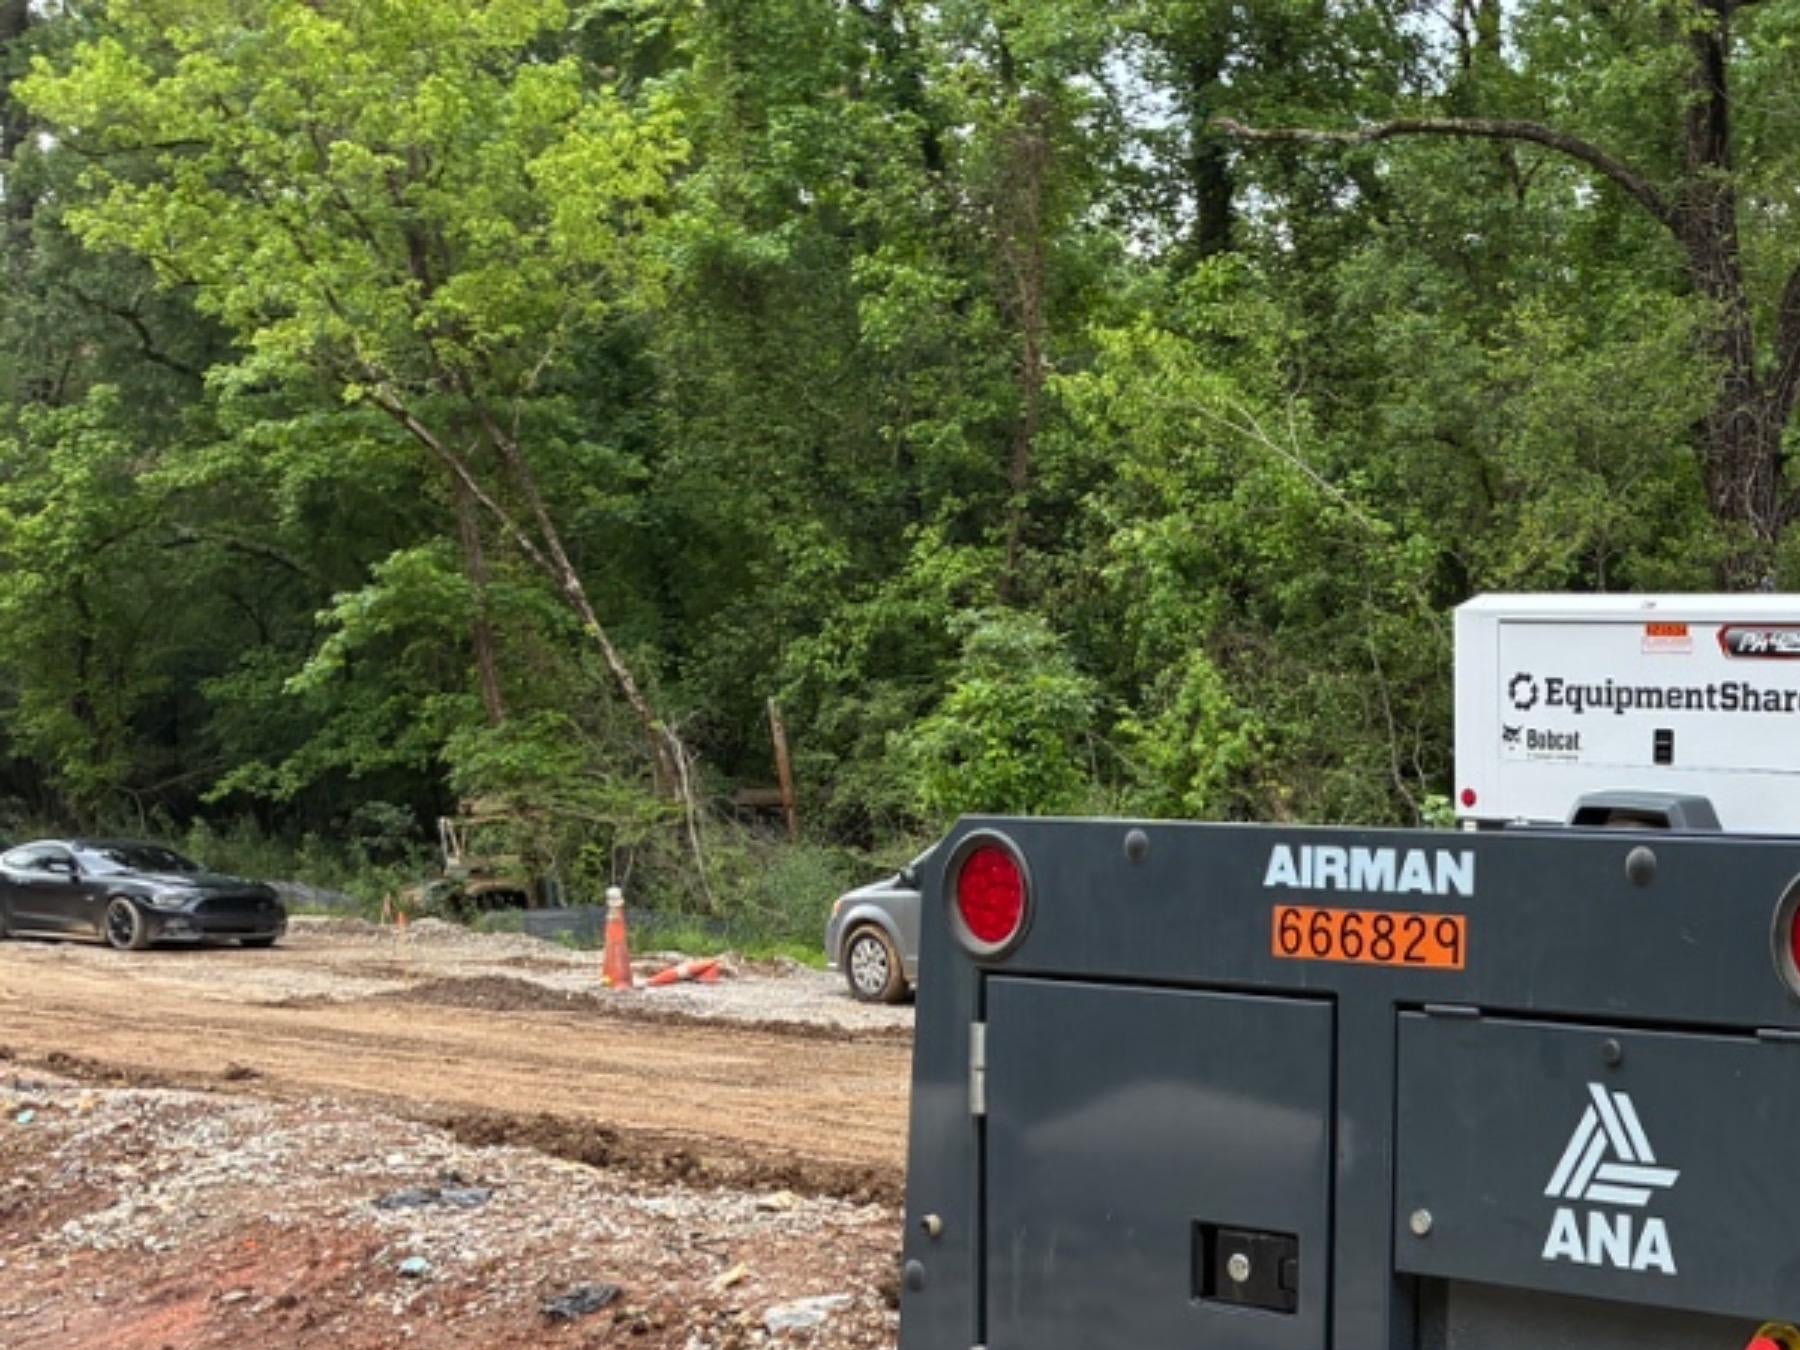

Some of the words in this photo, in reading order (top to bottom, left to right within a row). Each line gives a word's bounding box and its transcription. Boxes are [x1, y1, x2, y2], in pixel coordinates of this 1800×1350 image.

[1526, 727, 1580, 752] Bobcat
[1263, 844, 1476, 896] AIRMAN
[1277, 907, 1462, 966] 666829
[1541, 1207, 1678, 1275] ANA
